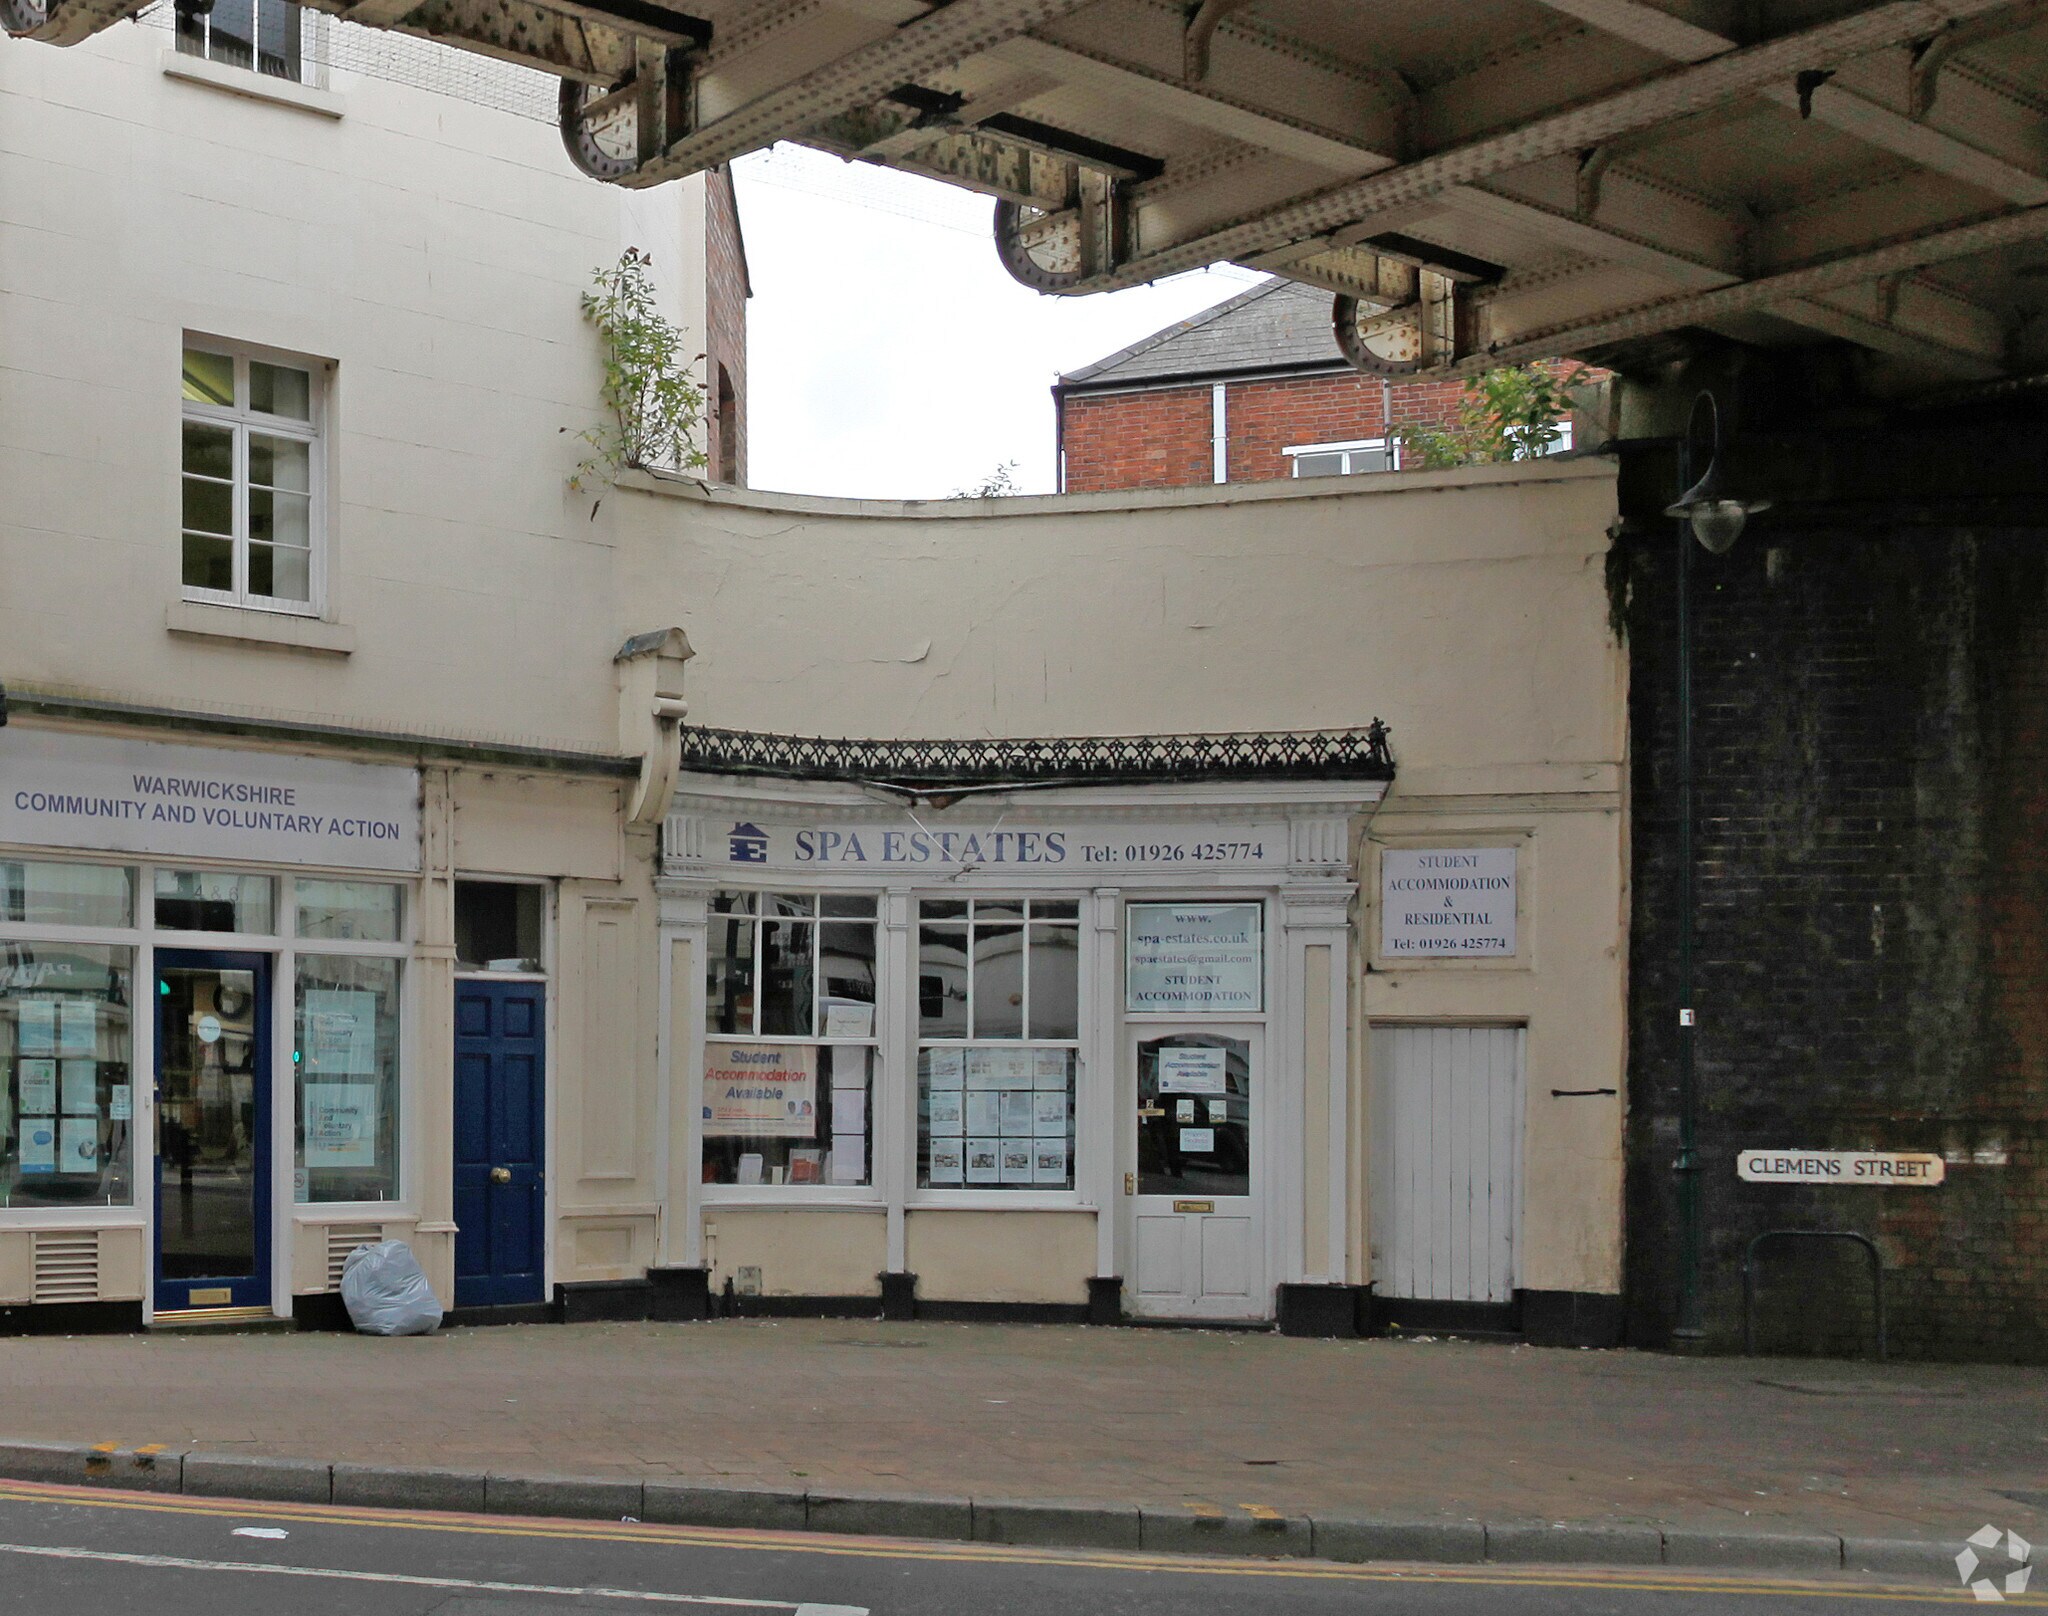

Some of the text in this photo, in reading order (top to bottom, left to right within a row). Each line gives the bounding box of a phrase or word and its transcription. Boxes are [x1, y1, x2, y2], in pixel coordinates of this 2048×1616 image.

[133, 775, 296, 806] WARWICKSHIRE
[15, 791, 400, 840] COMMUNITY AND VOLUNTARY ACTION
[795, 830, 1264, 863] SPA ESTATES Tel: 01926 425774
[1418, 855, 1479, 868] STUDENT
[1389, 877, 1510, 891] ACCOMMODATION
[1443, 895, 1453, 908] &
[1405, 912, 1493, 925] RESIDENTIAL
[1137, 932, 1249, 946] spa-estates.co.uk
[1393, 938, 1506, 949] Tel: 01926 425774
[1135, 954, 1252, 966] spaestates@gmail.com
[1164, 975, 1222, 985] STUDENT
[1135, 991, 1252, 1001] ACCOMMODATION
[730, 1050, 782, 1064] Student
[705, 1067, 807, 1081] Accommodation
[725, 1086, 784, 1100] Available
[1749, 1157, 1932, 1177] CLEMENS STREET
